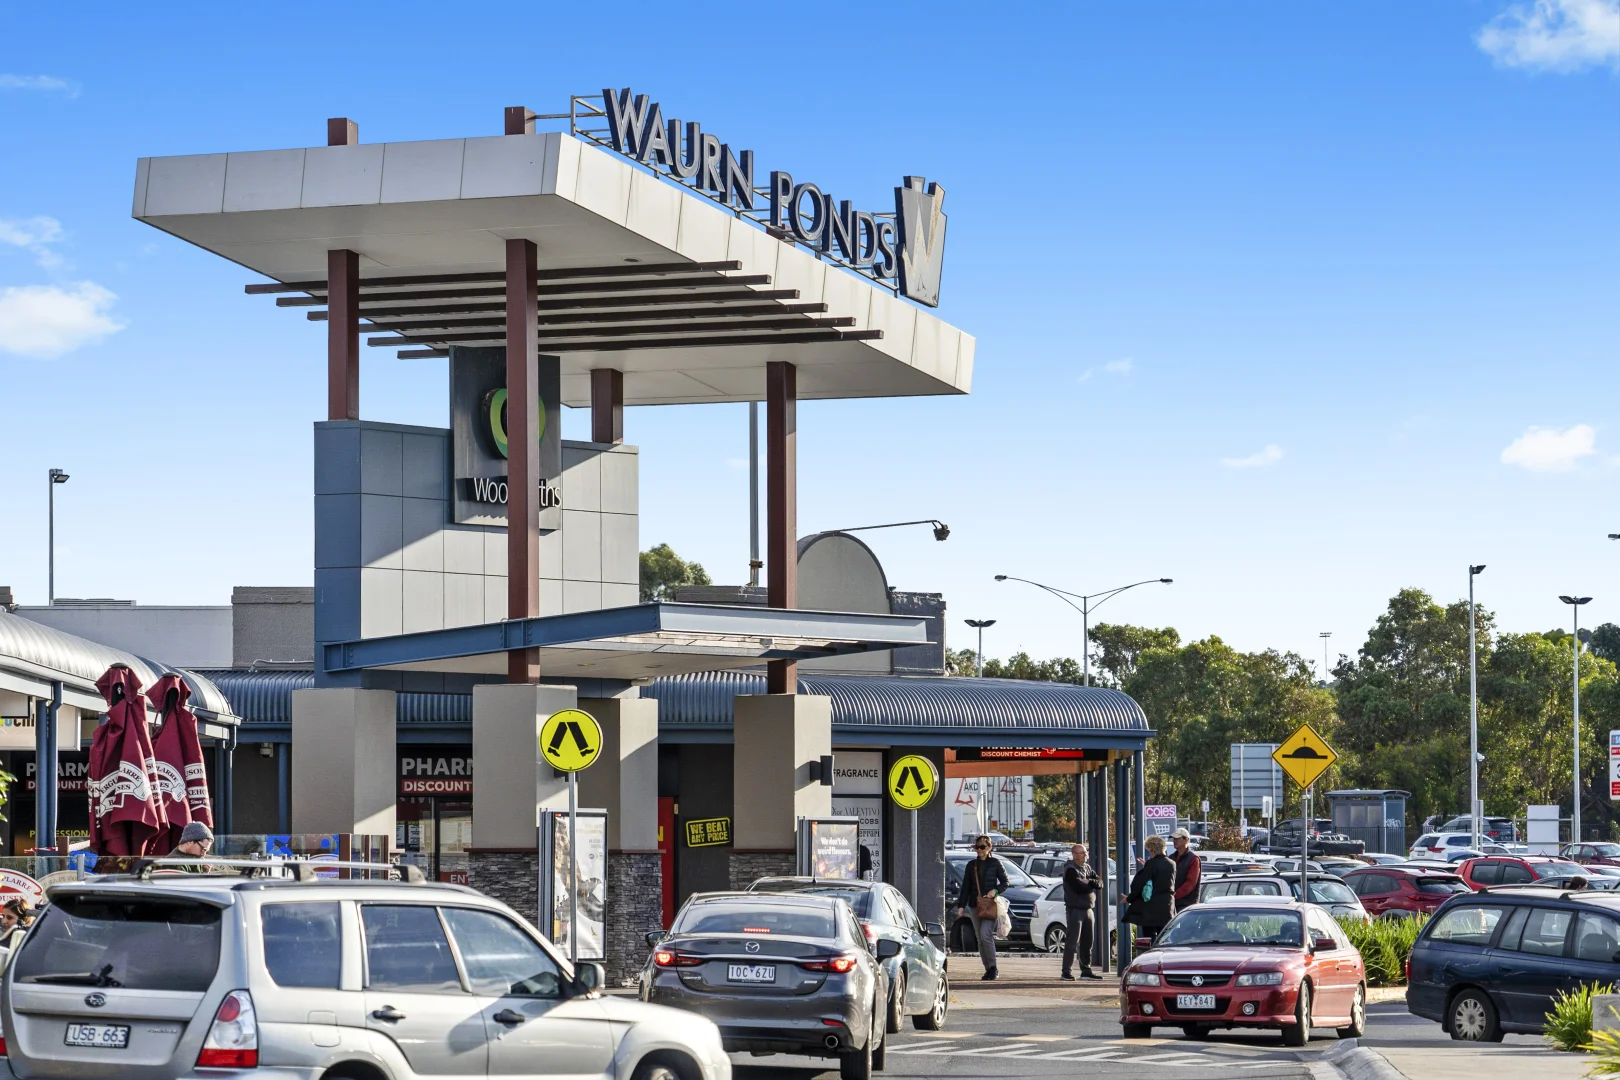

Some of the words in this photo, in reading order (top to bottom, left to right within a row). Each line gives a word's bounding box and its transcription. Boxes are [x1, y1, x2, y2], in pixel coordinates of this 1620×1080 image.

[602, 87, 754, 210] WAURN
[770, 170, 898, 280] PONDS
[473, 476, 561, 508] Wooths
[26, 762, 89, 777] PARM
[28, 780, 83, 789] DOUNT
[403, 781, 472, 792] DISCOUNT
[964, 782, 979, 791] AKD
[1009, 777, 1022, 785] AKD
[1146, 805, 1176, 817] coles
[690, 824, 704, 835] WE
[706, 821, 727, 833] BEAT
[691, 833, 705, 843] ANY
[707, 831, 729, 842] PRICE
[820, 837, 829, 846] We
[817, 847, 831, 856] weird
[755, 967, 774, 979] 6ZU
[1178, 996, 1193, 1006] XEY
